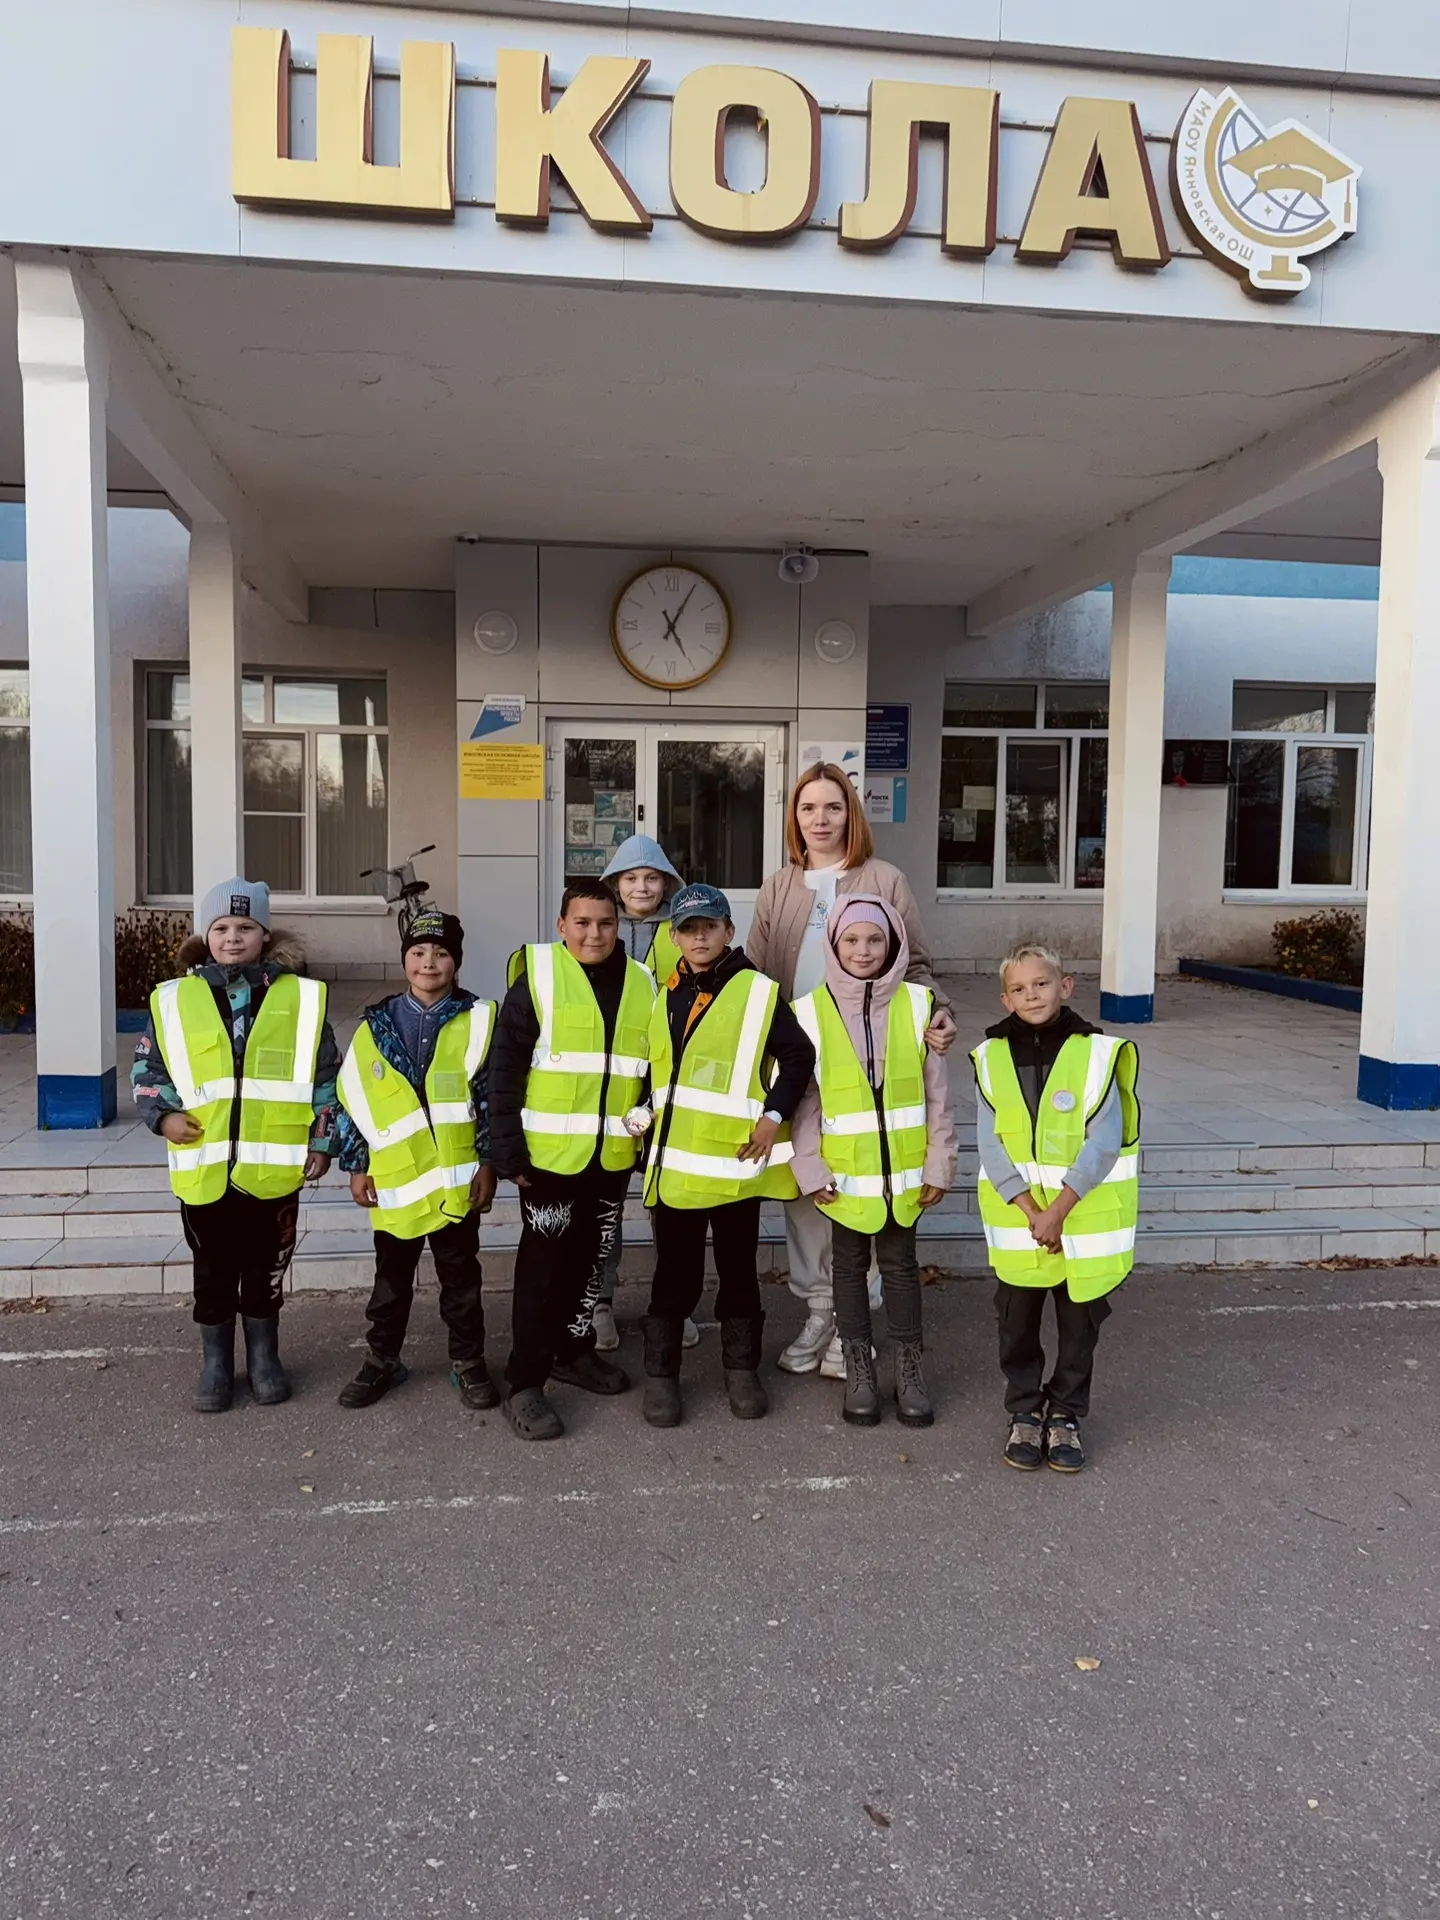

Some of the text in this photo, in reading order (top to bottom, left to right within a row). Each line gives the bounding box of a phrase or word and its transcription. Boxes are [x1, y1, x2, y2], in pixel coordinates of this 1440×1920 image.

[232, 27, 1170, 266] ШКОЛА
[1185, 101, 1212, 152] МАОУ
[1227, 237, 1255, 262] ОШ
[664, 575, 680, 592] XII
[665, 661, 677, 677] VI
